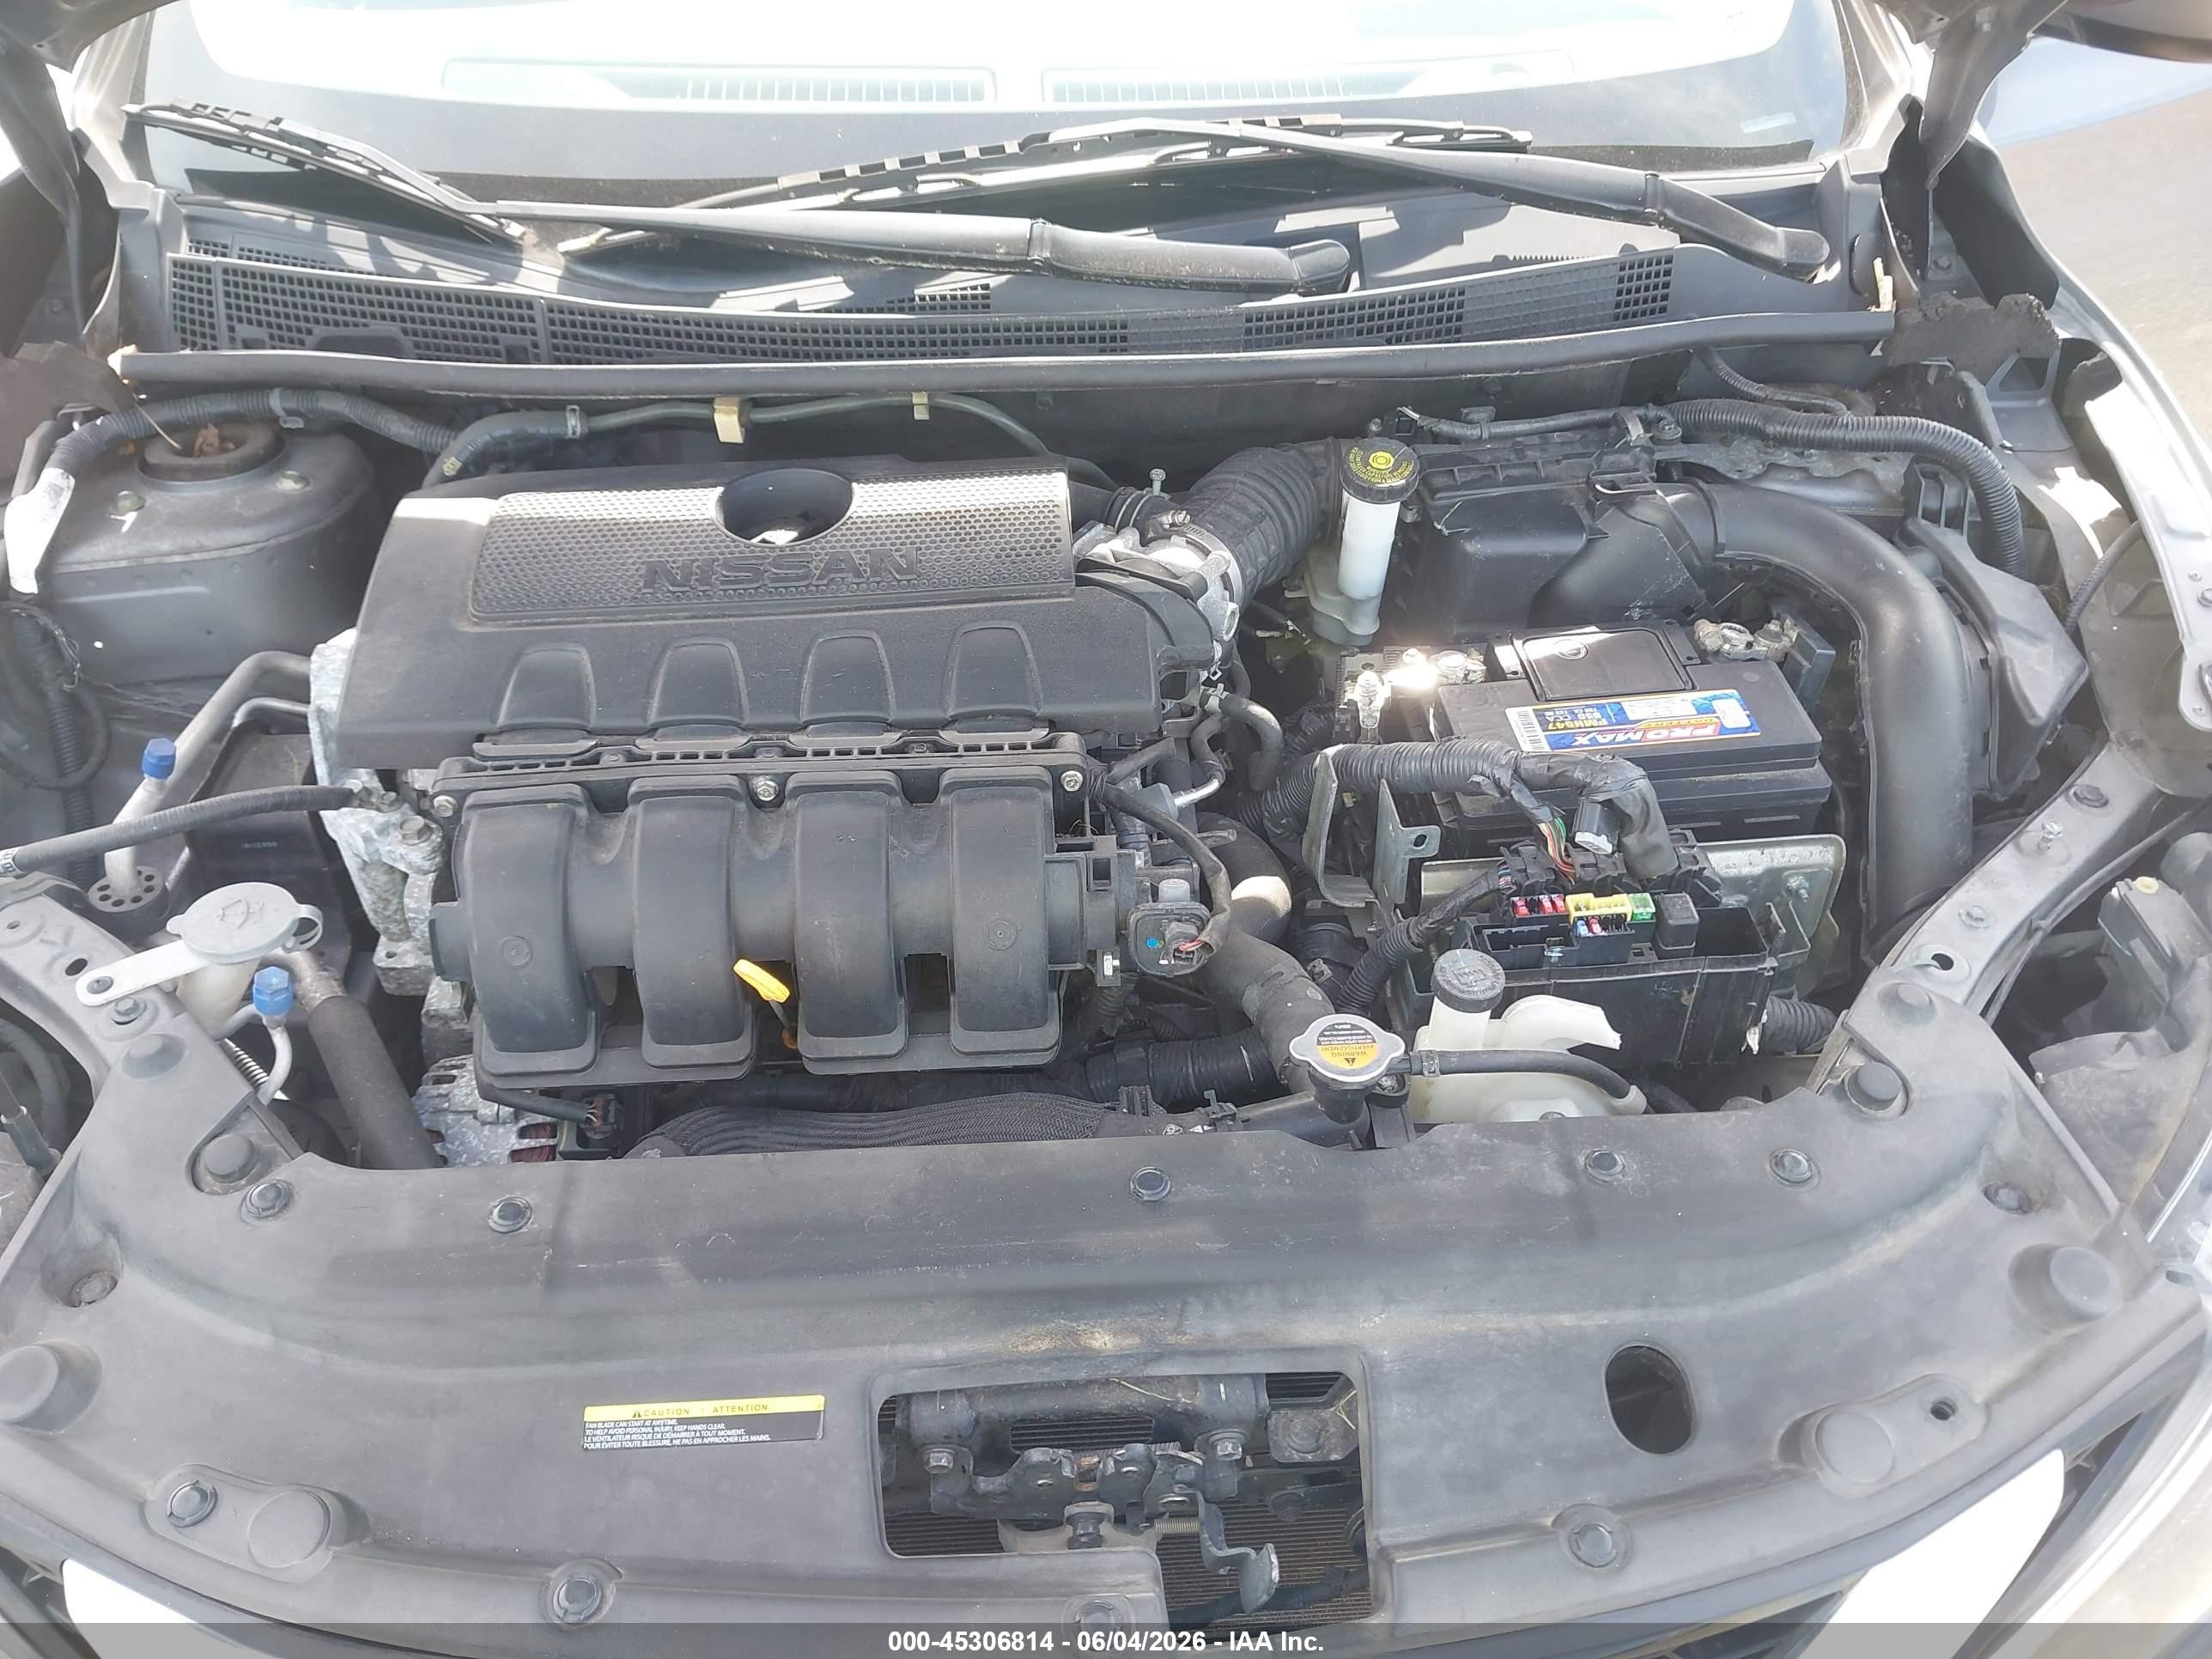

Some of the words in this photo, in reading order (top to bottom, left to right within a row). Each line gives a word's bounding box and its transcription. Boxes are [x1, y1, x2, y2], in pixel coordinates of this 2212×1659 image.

[643, 548, 919, 592] NISSAN
[644, 1408, 690, 1417] CAUTION
[713, 1404, 769, 1413] ATTENTION
[631, 1432, 653, 1441] RISQUE
[663, 1430, 695, 1438] DÉMARRER
